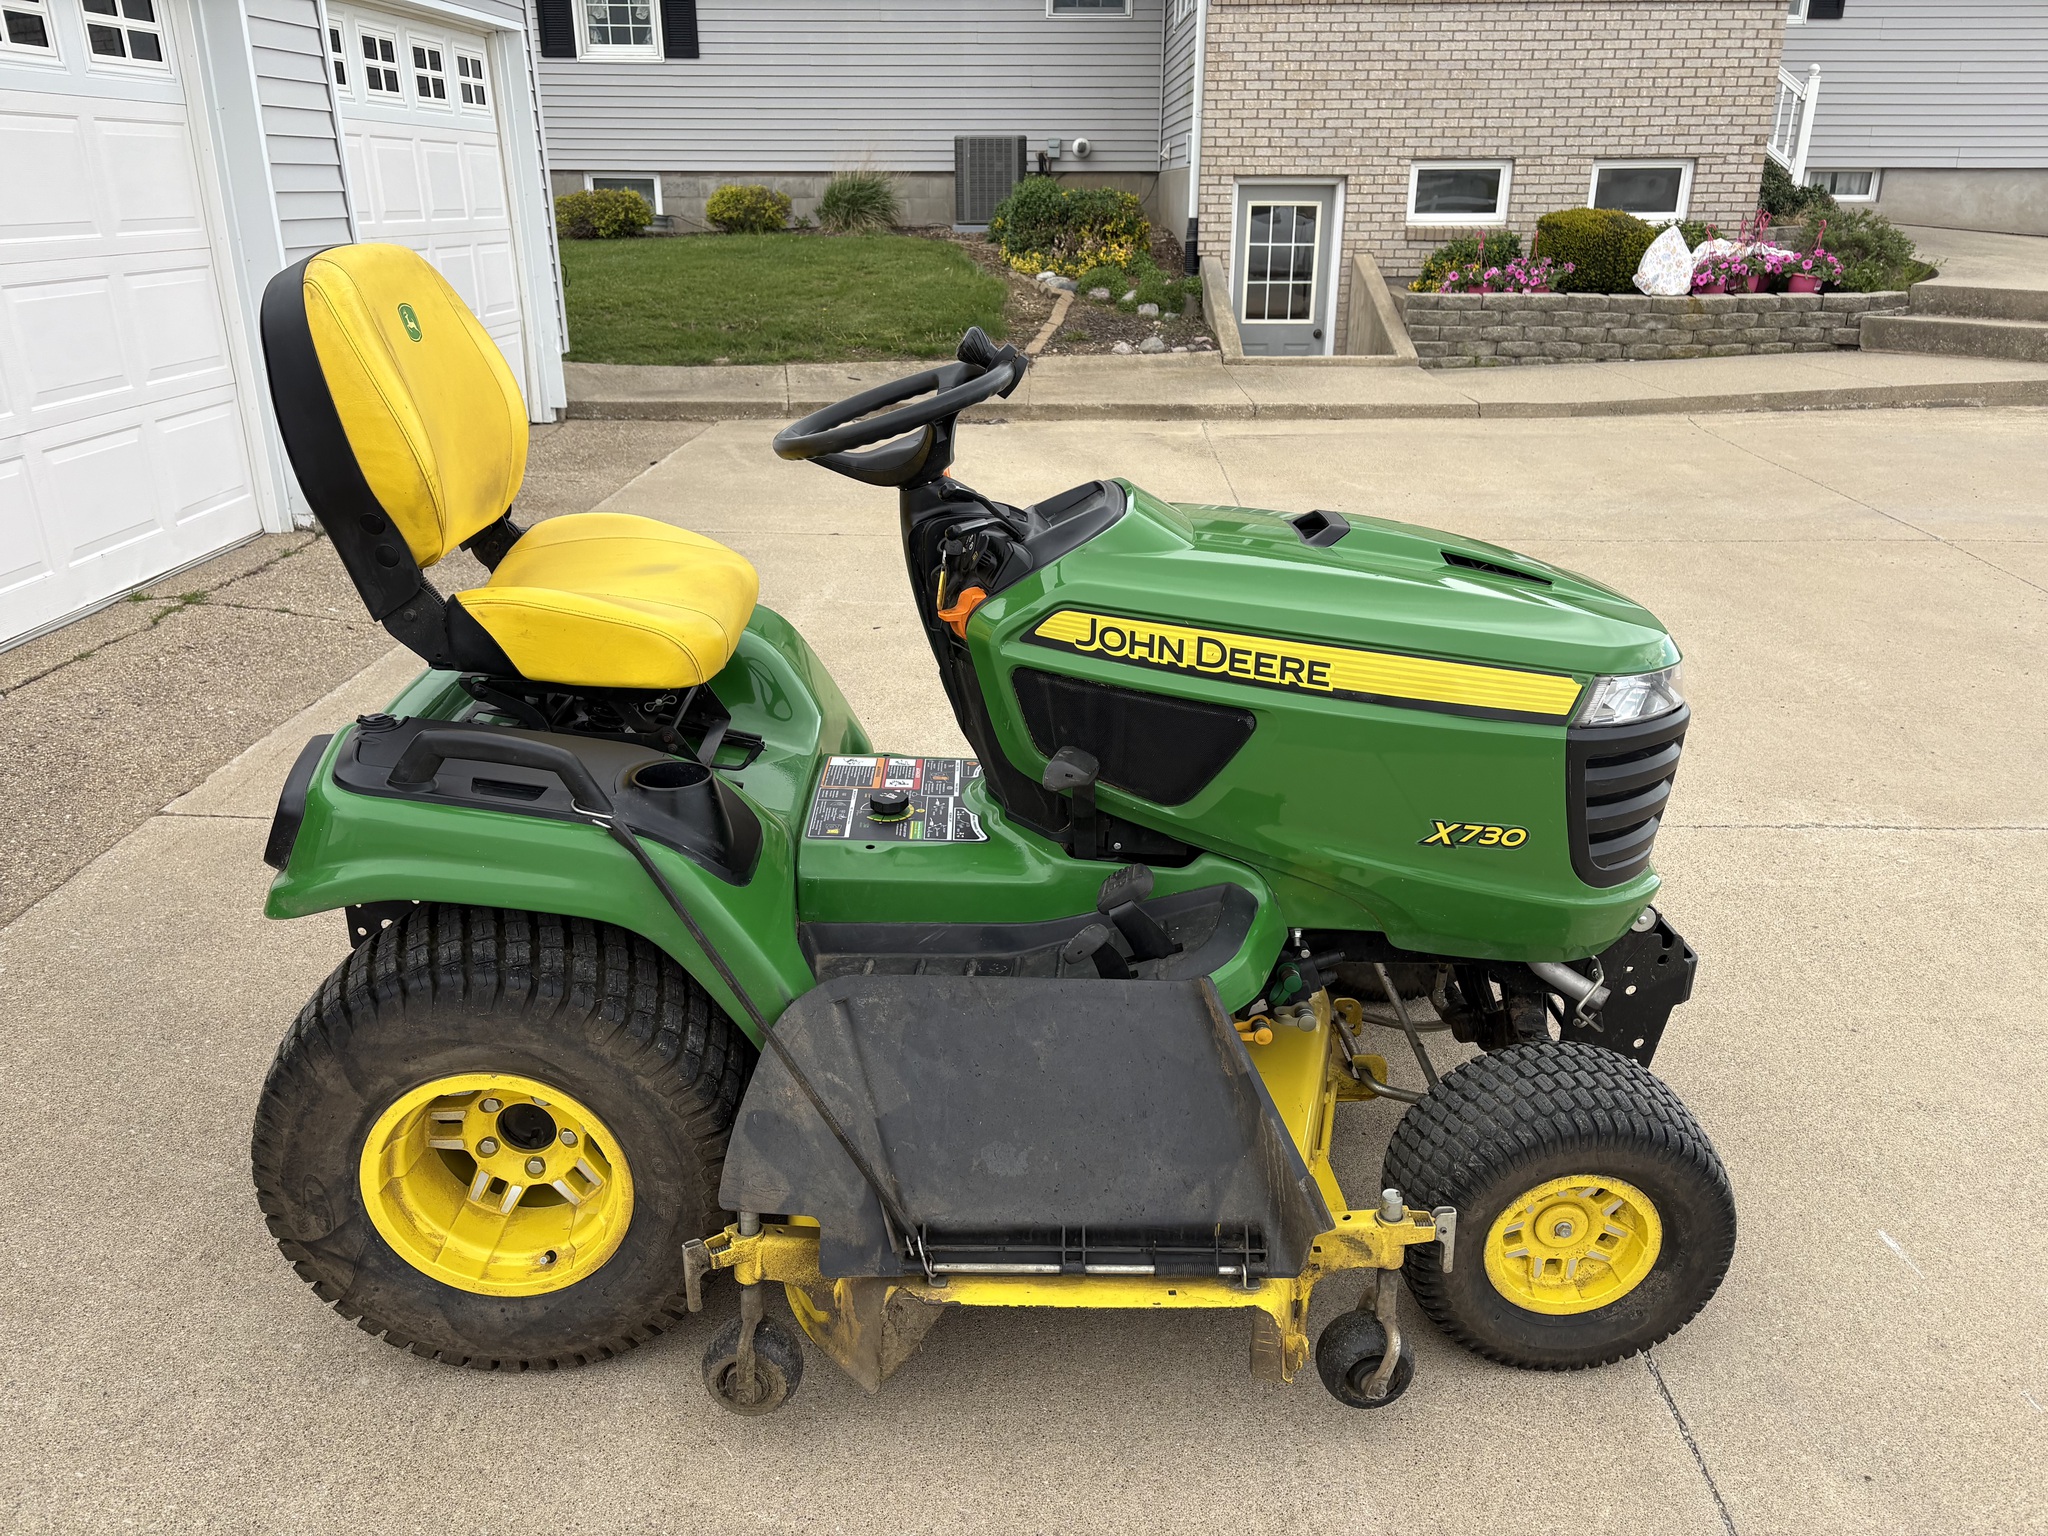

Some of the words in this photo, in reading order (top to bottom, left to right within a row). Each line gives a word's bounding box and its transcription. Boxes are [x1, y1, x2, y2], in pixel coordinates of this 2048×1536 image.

[1075, 617, 1185, 664] JOHN
[1196, 636, 1332, 688] DEERE
[1419, 820, 1529, 848] X730
